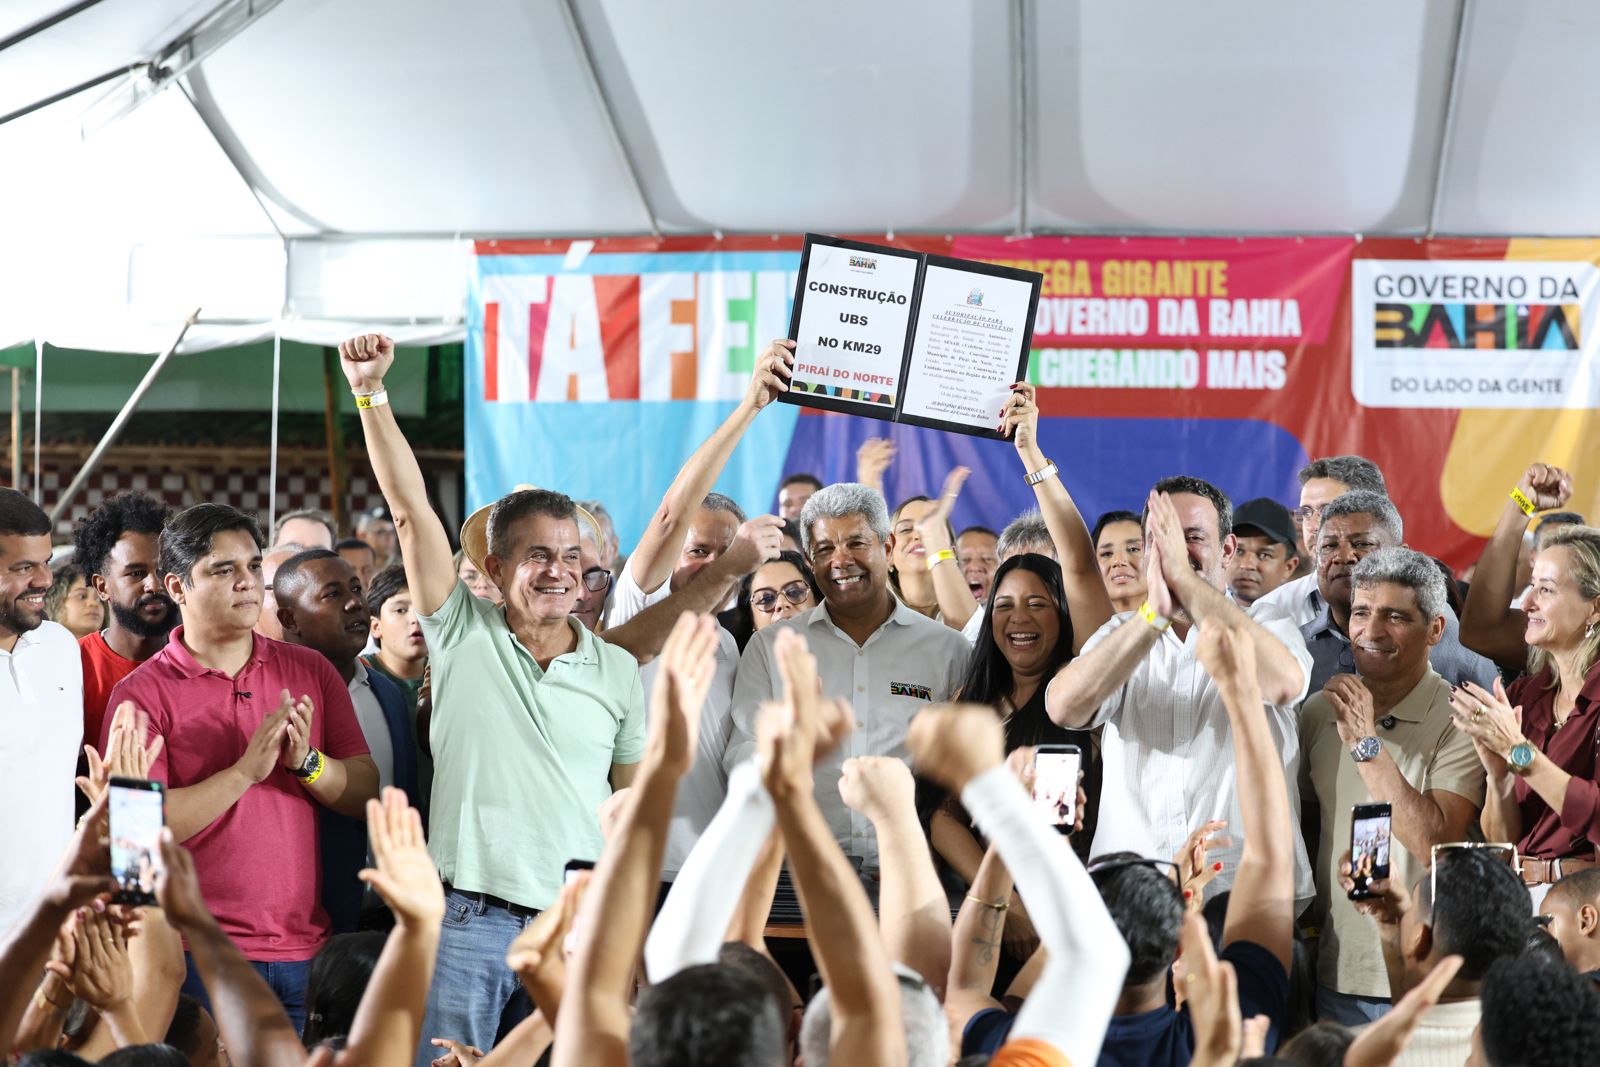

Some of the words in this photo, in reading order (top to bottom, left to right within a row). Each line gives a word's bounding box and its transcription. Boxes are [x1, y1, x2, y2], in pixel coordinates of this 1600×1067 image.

[849, 260, 876, 270] BAHIA
[1102, 260, 1228, 296] GIGANTE
[1374, 275, 1527, 299] GOVERNO
[1540, 277, 1580, 300] DA
[808, 281, 907, 305] CONSTRUÇÃO
[484, 240, 610, 402] TÁ
[640, 271, 798, 402] FEI
[839, 312, 868, 326] UBS
[1032, 298, 1149, 336] OVERNO
[1158, 298, 1200, 336] DA
[1208, 298, 1302, 336] BAHIA
[1375, 303, 1580, 350] BAHIA
[818, 336, 838, 348] NO
[843, 340, 882, 355] KM29
[798, 364, 829, 376] PIRAÍ
[833, 369, 849, 379] DO
[853, 372, 894, 386] NORTE
[1039, 349, 1200, 388] CHEGANDO
[1206, 350, 1286, 390] MAIS
[1390, 378, 1418, 392] DO
[1424, 378, 1473, 393] LADO
[1478, 379, 1502, 394] DA
[1506, 378, 1564, 394] GENTE
